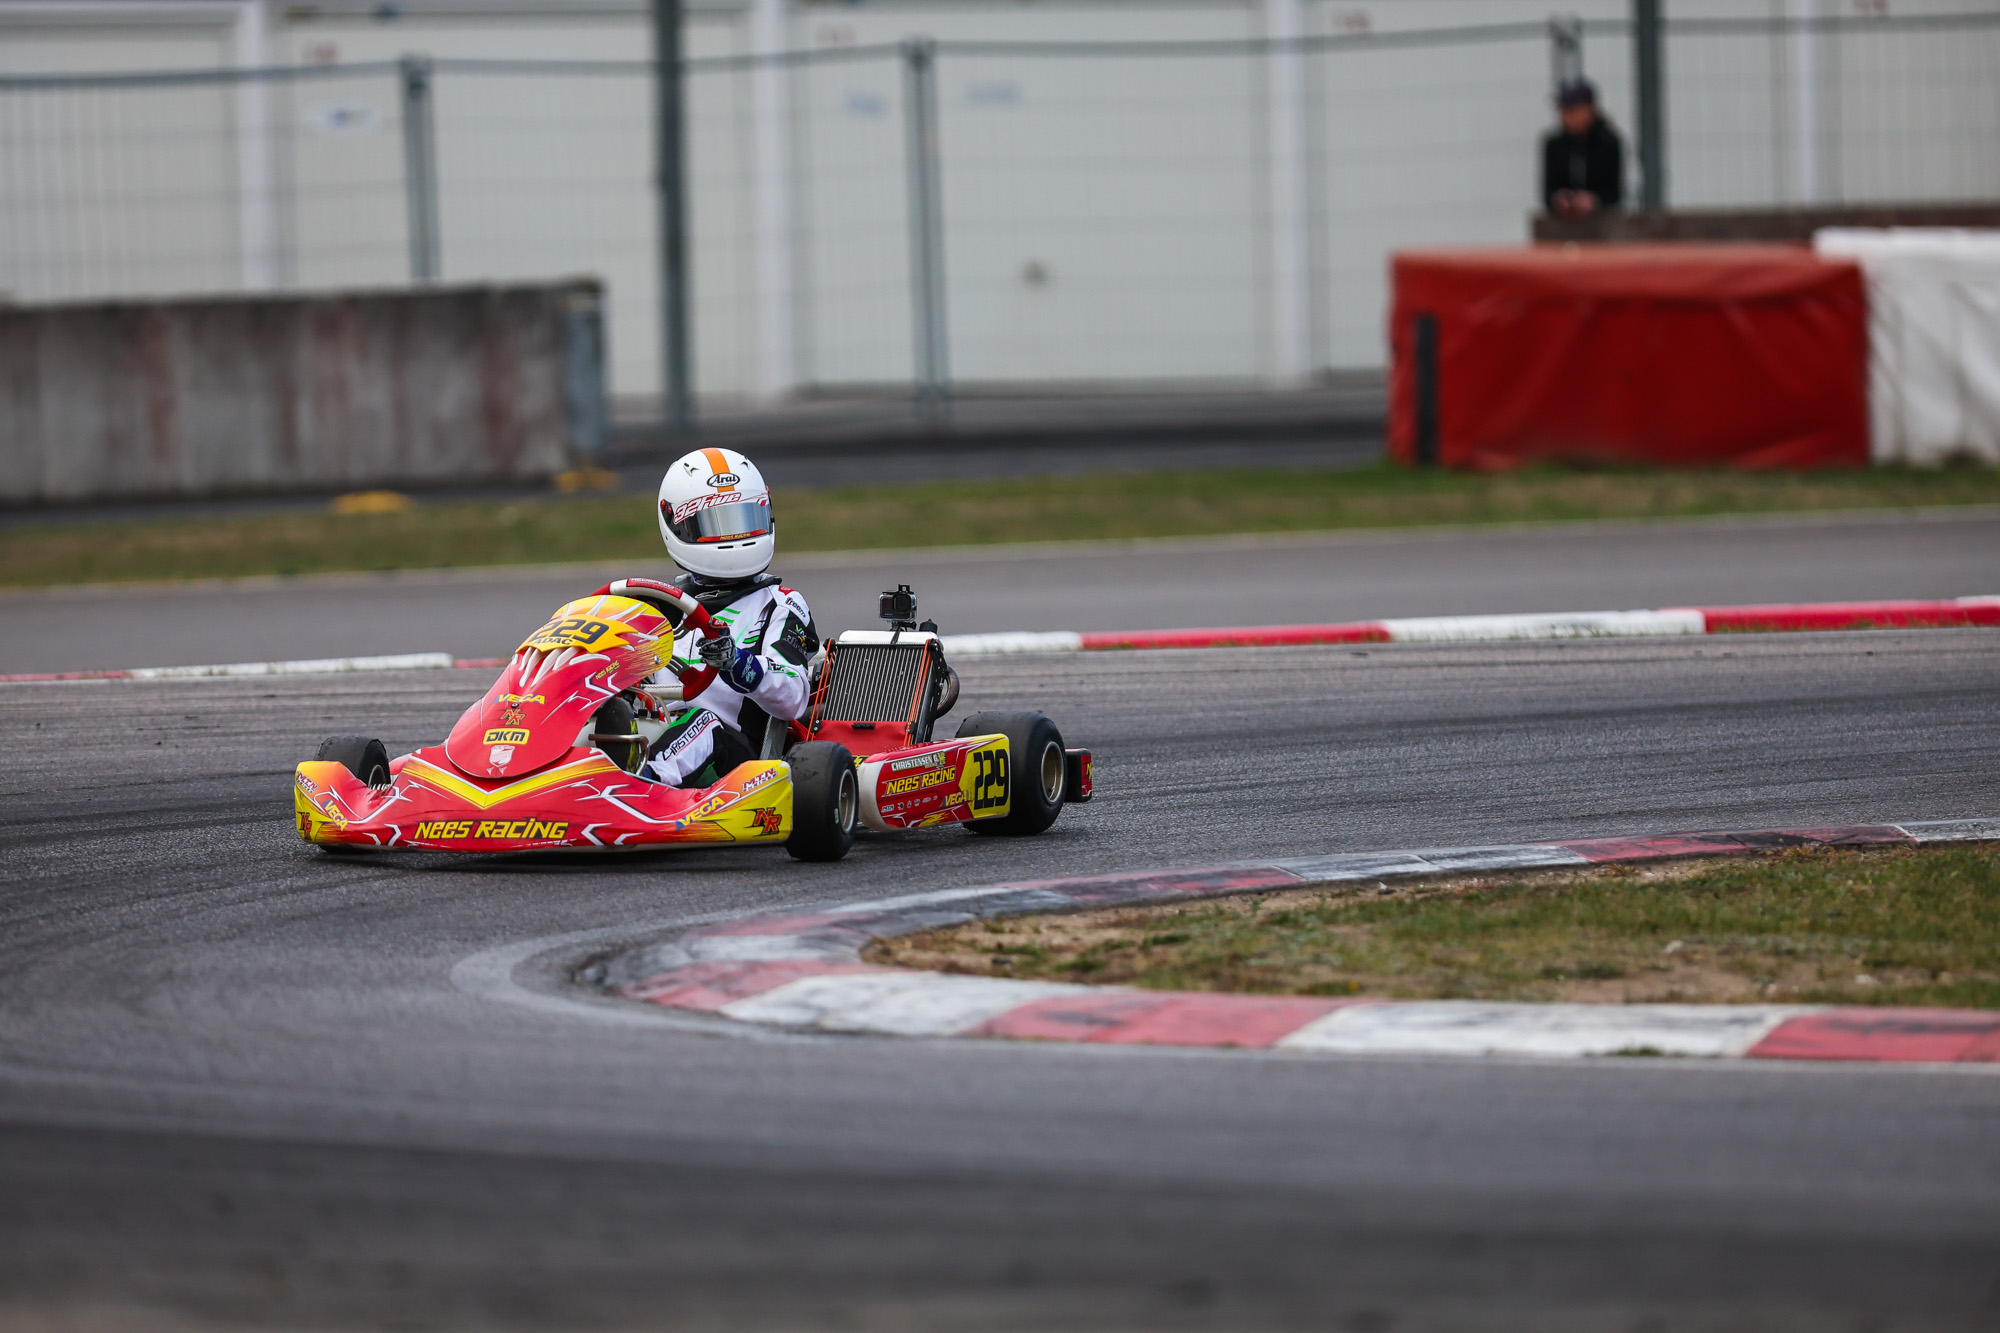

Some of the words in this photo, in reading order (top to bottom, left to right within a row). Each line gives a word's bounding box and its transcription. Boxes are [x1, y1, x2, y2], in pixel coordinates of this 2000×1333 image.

[711, 474, 736, 485] Arai
[528, 619, 609, 644] 229
[533, 637, 573, 645] ADAC
[498, 693, 545, 705] VEGA
[486, 731, 526, 742] DKM
[891, 755, 933, 771] CHRISTENSEN
[743, 767, 775, 789] MTN
[973, 749, 1009, 810] 229
[943, 790, 968, 807] VEGA
[324, 799, 348, 831] VEGA
[677, 796, 726, 826] VEGA
